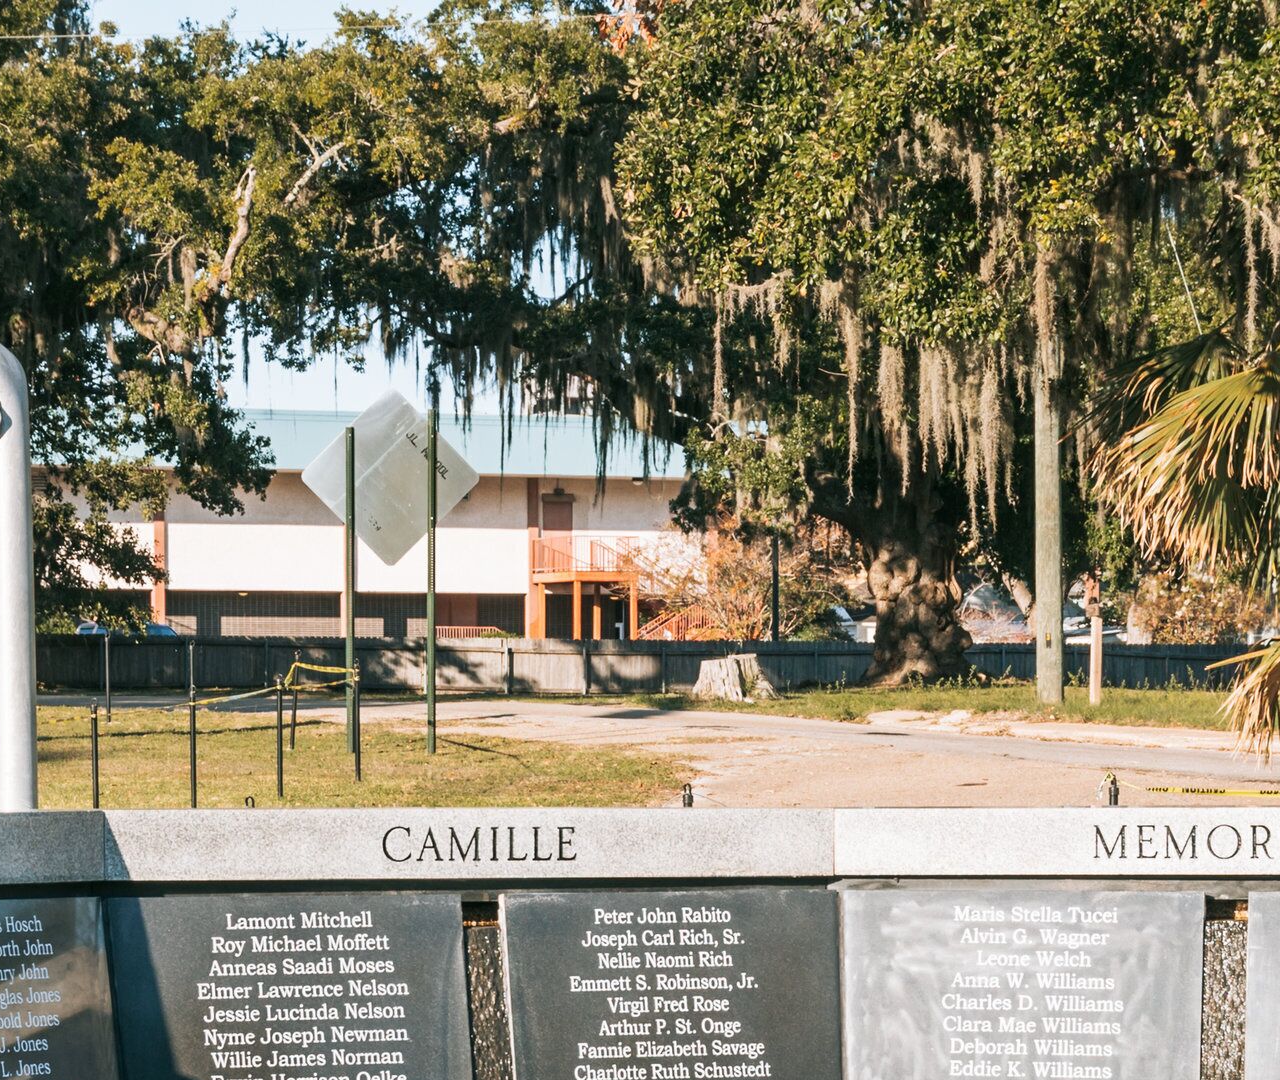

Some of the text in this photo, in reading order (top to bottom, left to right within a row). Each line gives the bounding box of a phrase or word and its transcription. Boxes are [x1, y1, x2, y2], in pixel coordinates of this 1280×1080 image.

[382, 826, 577, 862] CAMILLE
[5, 915, 43, 932] Hosch
[226, 911, 373, 930] Lamont Mitchell
[594, 906, 731, 925] Peter John Rabito
[954, 905, 1118, 924] Maris Stella Tucei
[23, 939, 53, 956] John
[978, 951, 1091, 967] Leone Welch
[196, 979, 410, 1000] Elmer Lawrence Nelson
[569, 972, 758, 992] Emmett S. Robinson, Jr.
[26, 987, 61, 1003] Jones
[943, 1016, 1121, 1034] Clara Mae Williams
[203, 1026, 412, 1050] Nyme Joseph Newman
[577, 1040, 765, 1060] Fannie Elizabeth Savage
